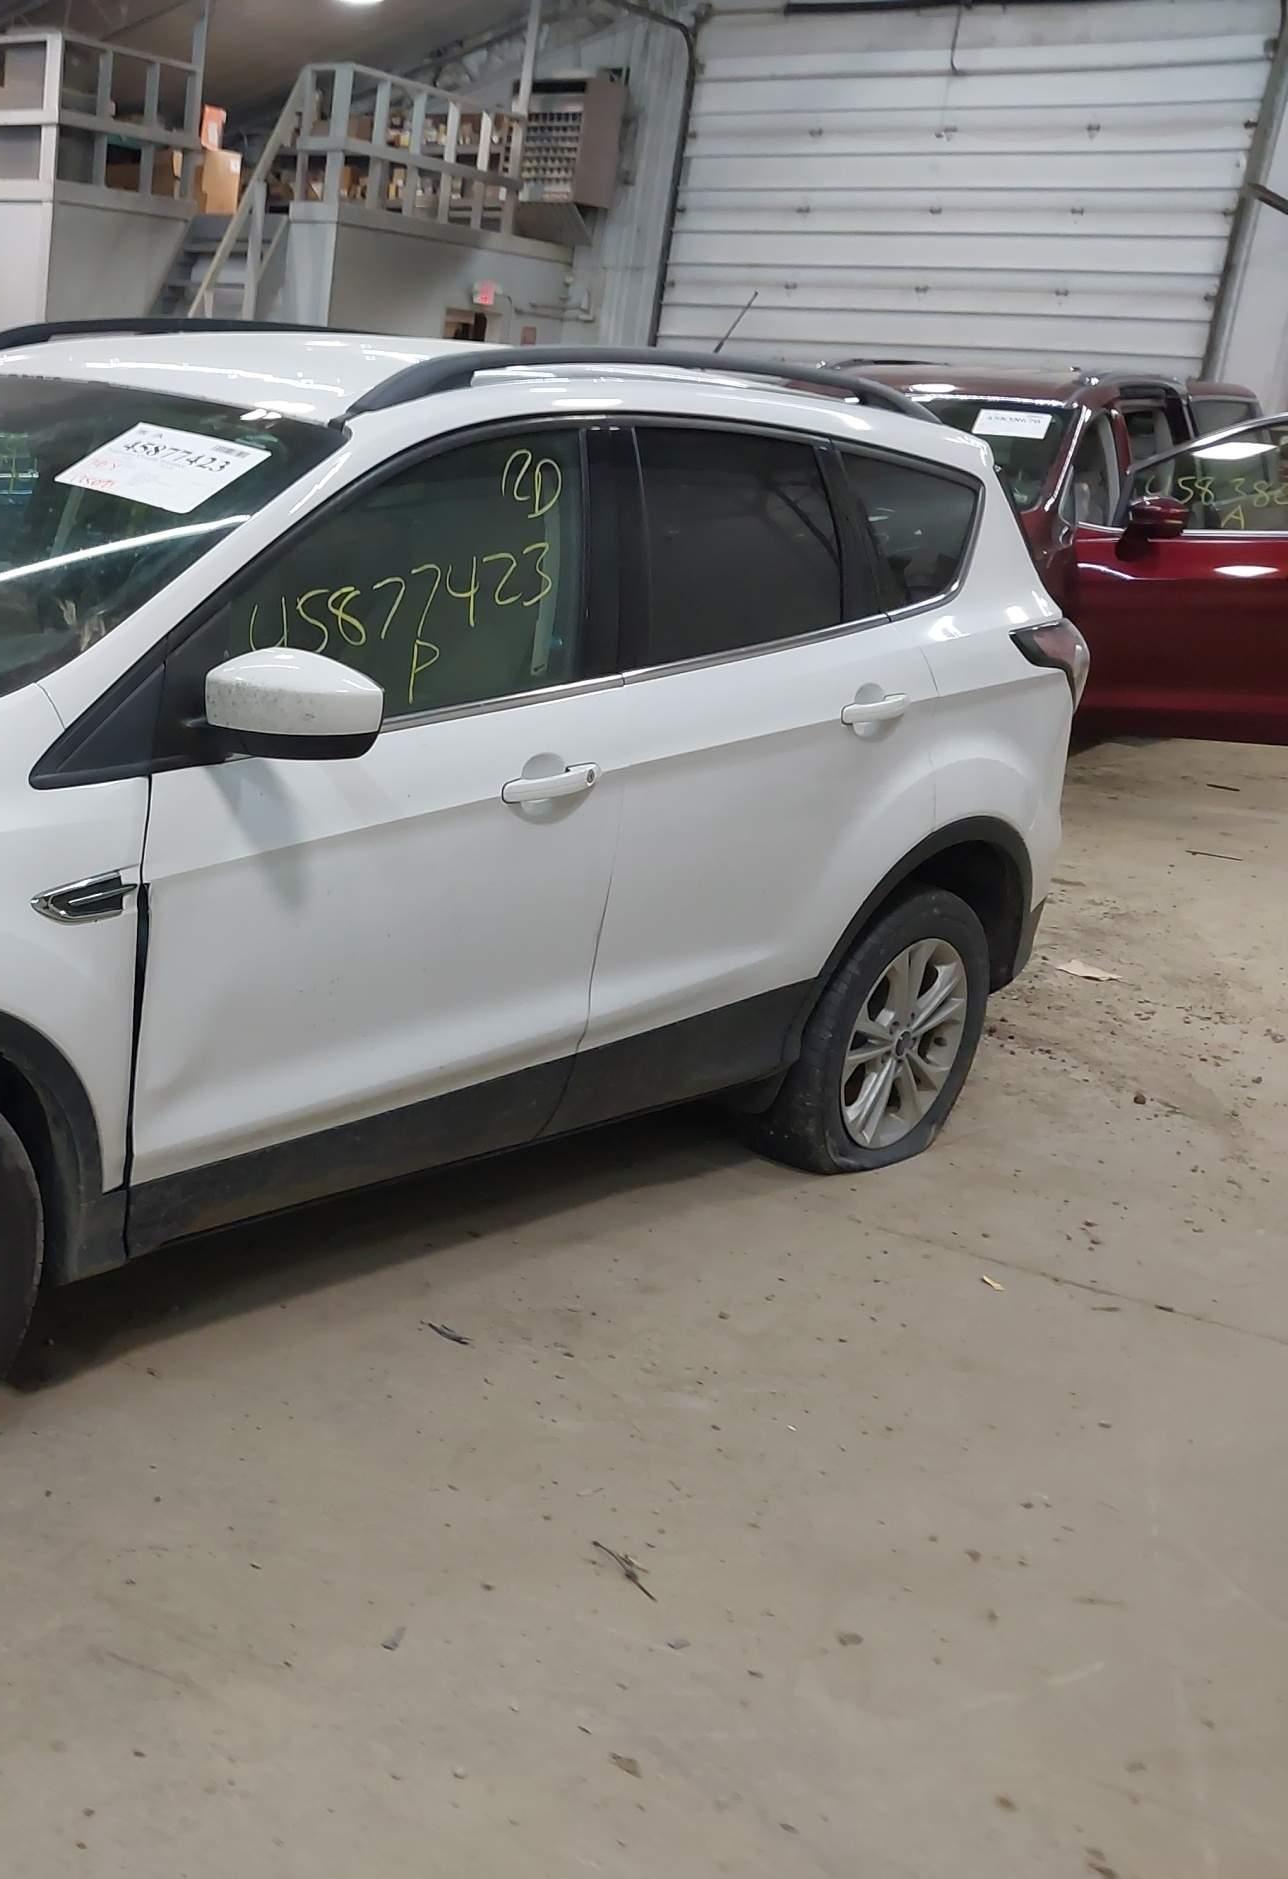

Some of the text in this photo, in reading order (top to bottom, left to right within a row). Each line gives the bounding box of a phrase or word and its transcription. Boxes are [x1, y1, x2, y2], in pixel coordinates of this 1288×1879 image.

[123, 441, 231, 472] 45877423
[1220, 503, 1246, 530] A
[407, 639, 441, 705] P
